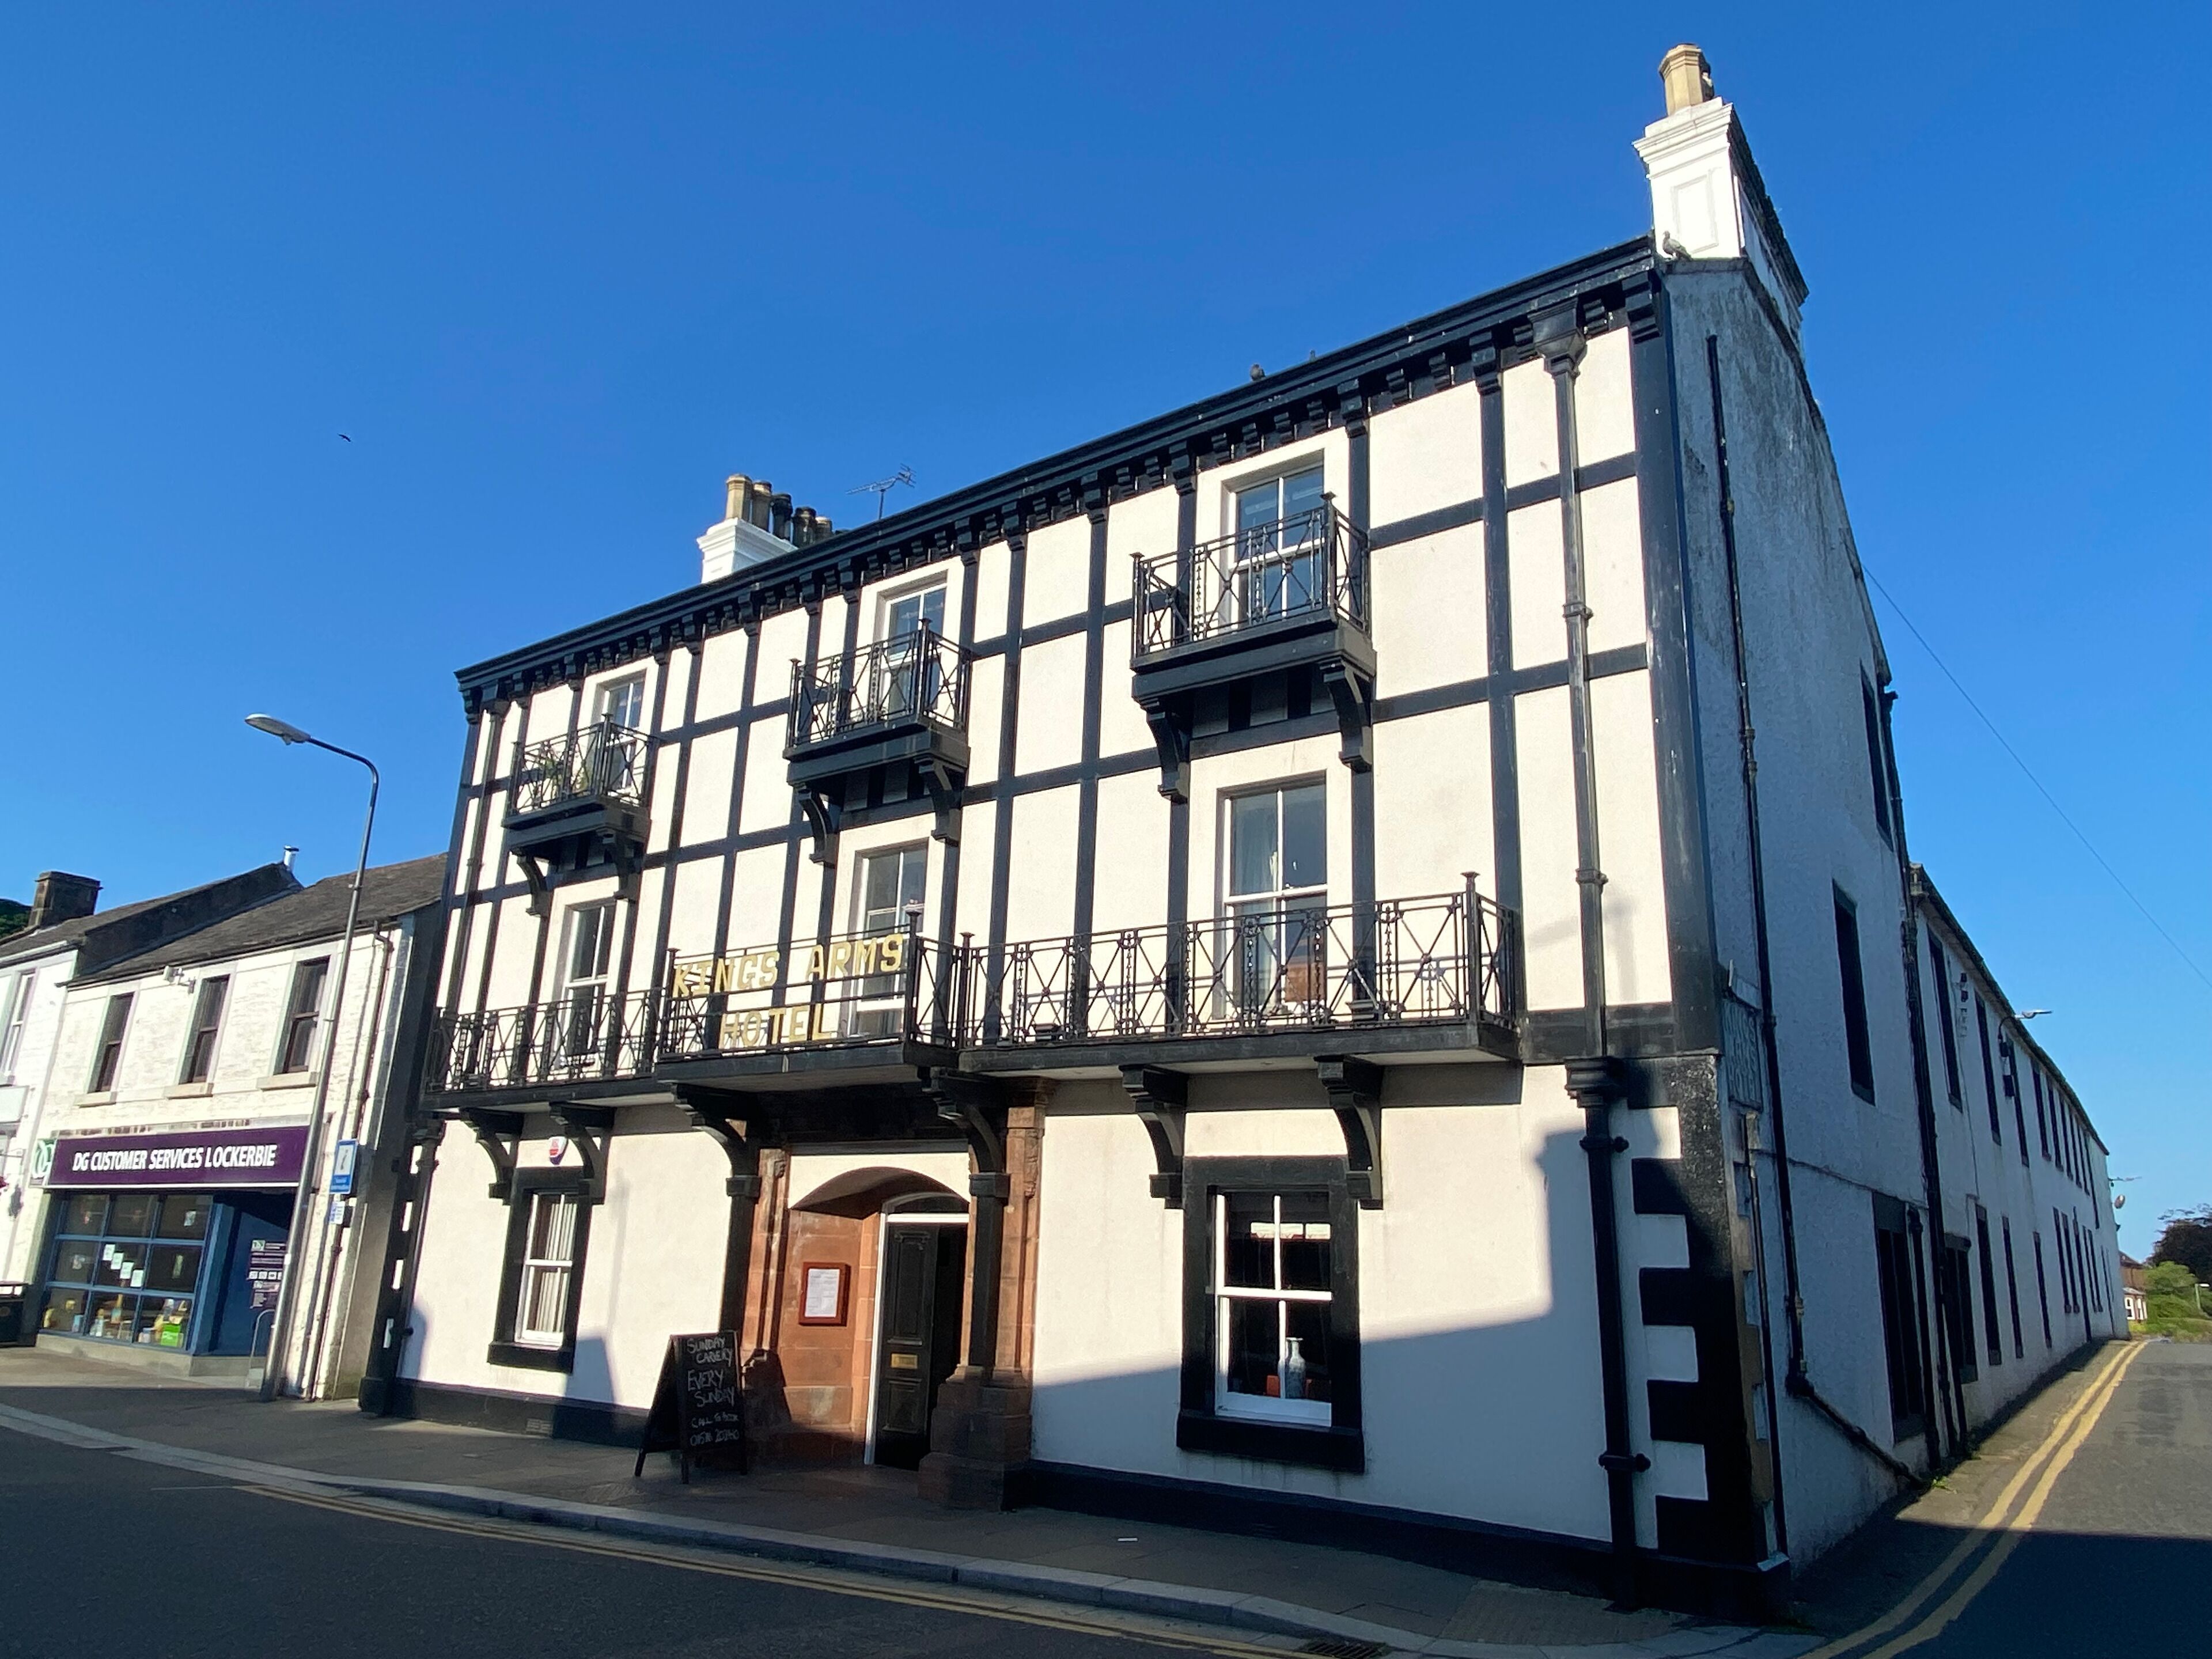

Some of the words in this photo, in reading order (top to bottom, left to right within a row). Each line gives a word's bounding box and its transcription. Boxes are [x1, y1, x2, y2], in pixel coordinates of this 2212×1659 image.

[673, 950, 780, 997] KINGS
[806, 933, 903, 982] ARMS
[718, 1003, 832, 1049] HOTEL
[72, 1152, 90, 1171] DG
[90, 1149, 147, 1171] CUSTOMER
[148, 1147, 204, 1170] SERVICES
[204, 1144, 278, 1168] LOCKERBIE
[687, 1336, 726, 1354] SUNDAY
[687, 1369, 724, 1392] EVERY
[694, 1386, 735, 1408] SUNDAY
